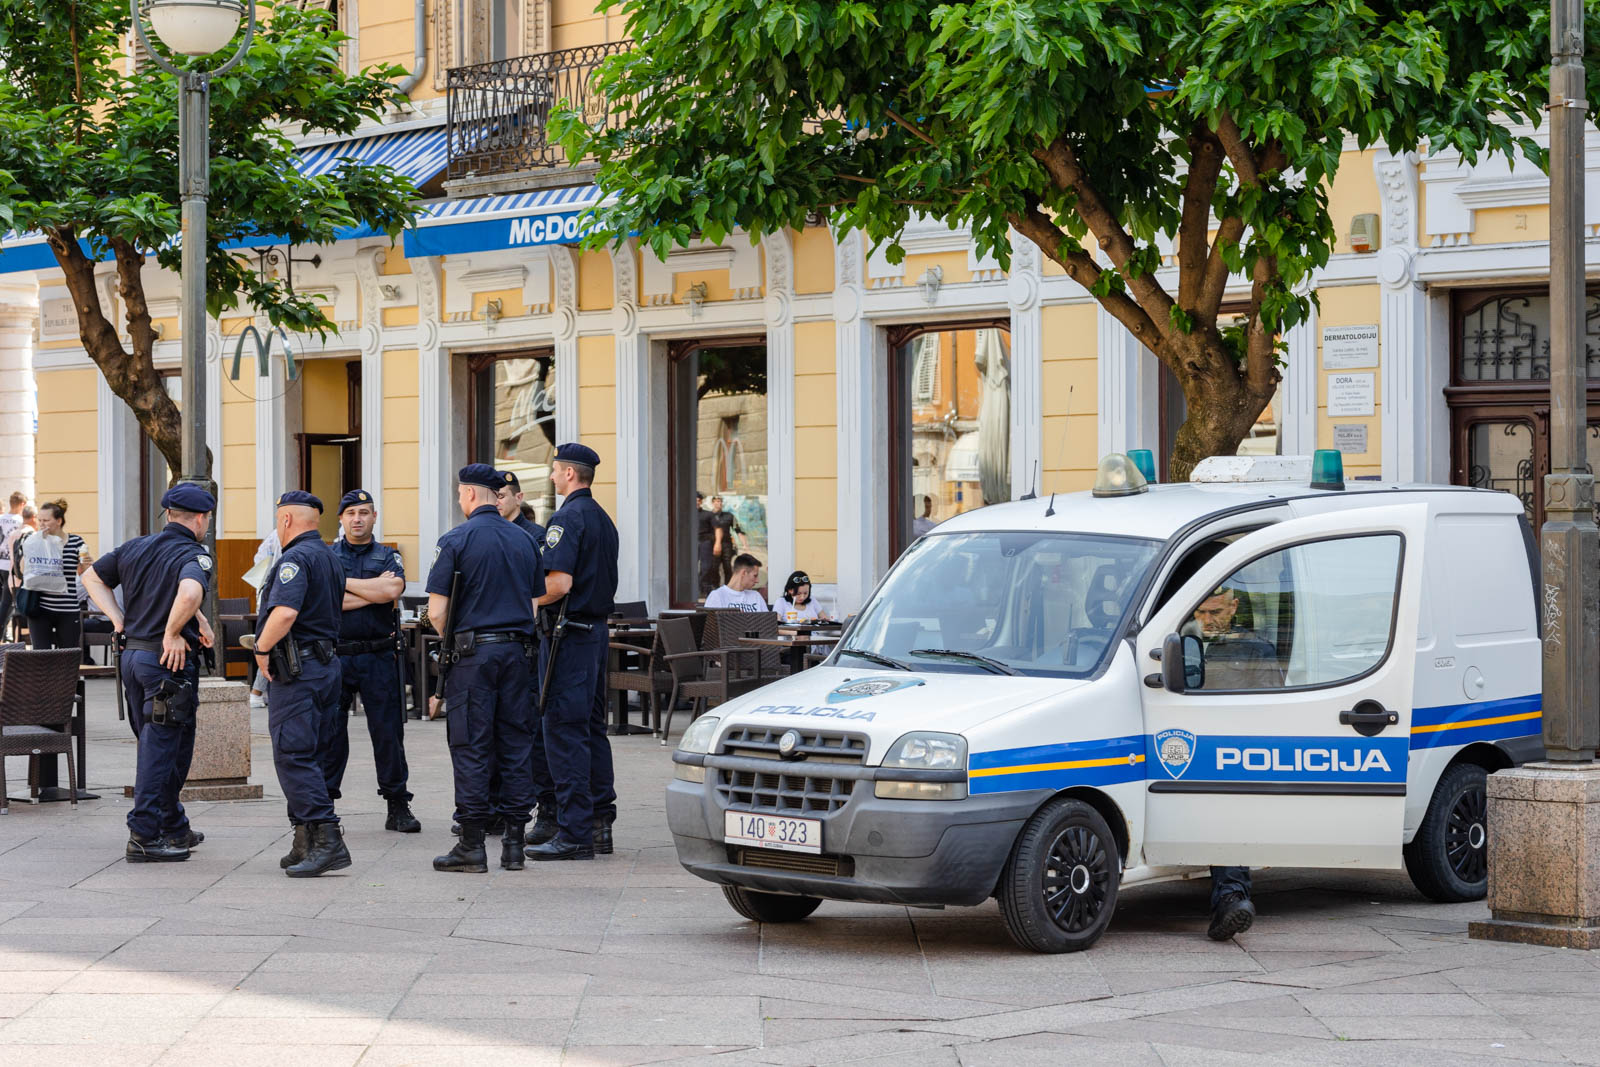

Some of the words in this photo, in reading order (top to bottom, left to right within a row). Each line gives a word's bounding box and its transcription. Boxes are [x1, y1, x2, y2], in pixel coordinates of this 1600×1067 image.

[1324, 333, 1377, 341] DERMATOLOGIJU
[749, 705, 877, 722] POLICIJA
[1157, 731, 1194, 741] POLICIJA
[1216, 748, 1392, 772] POLICIJA
[740, 816, 765, 839] 140
[778, 820, 807, 844] 323
